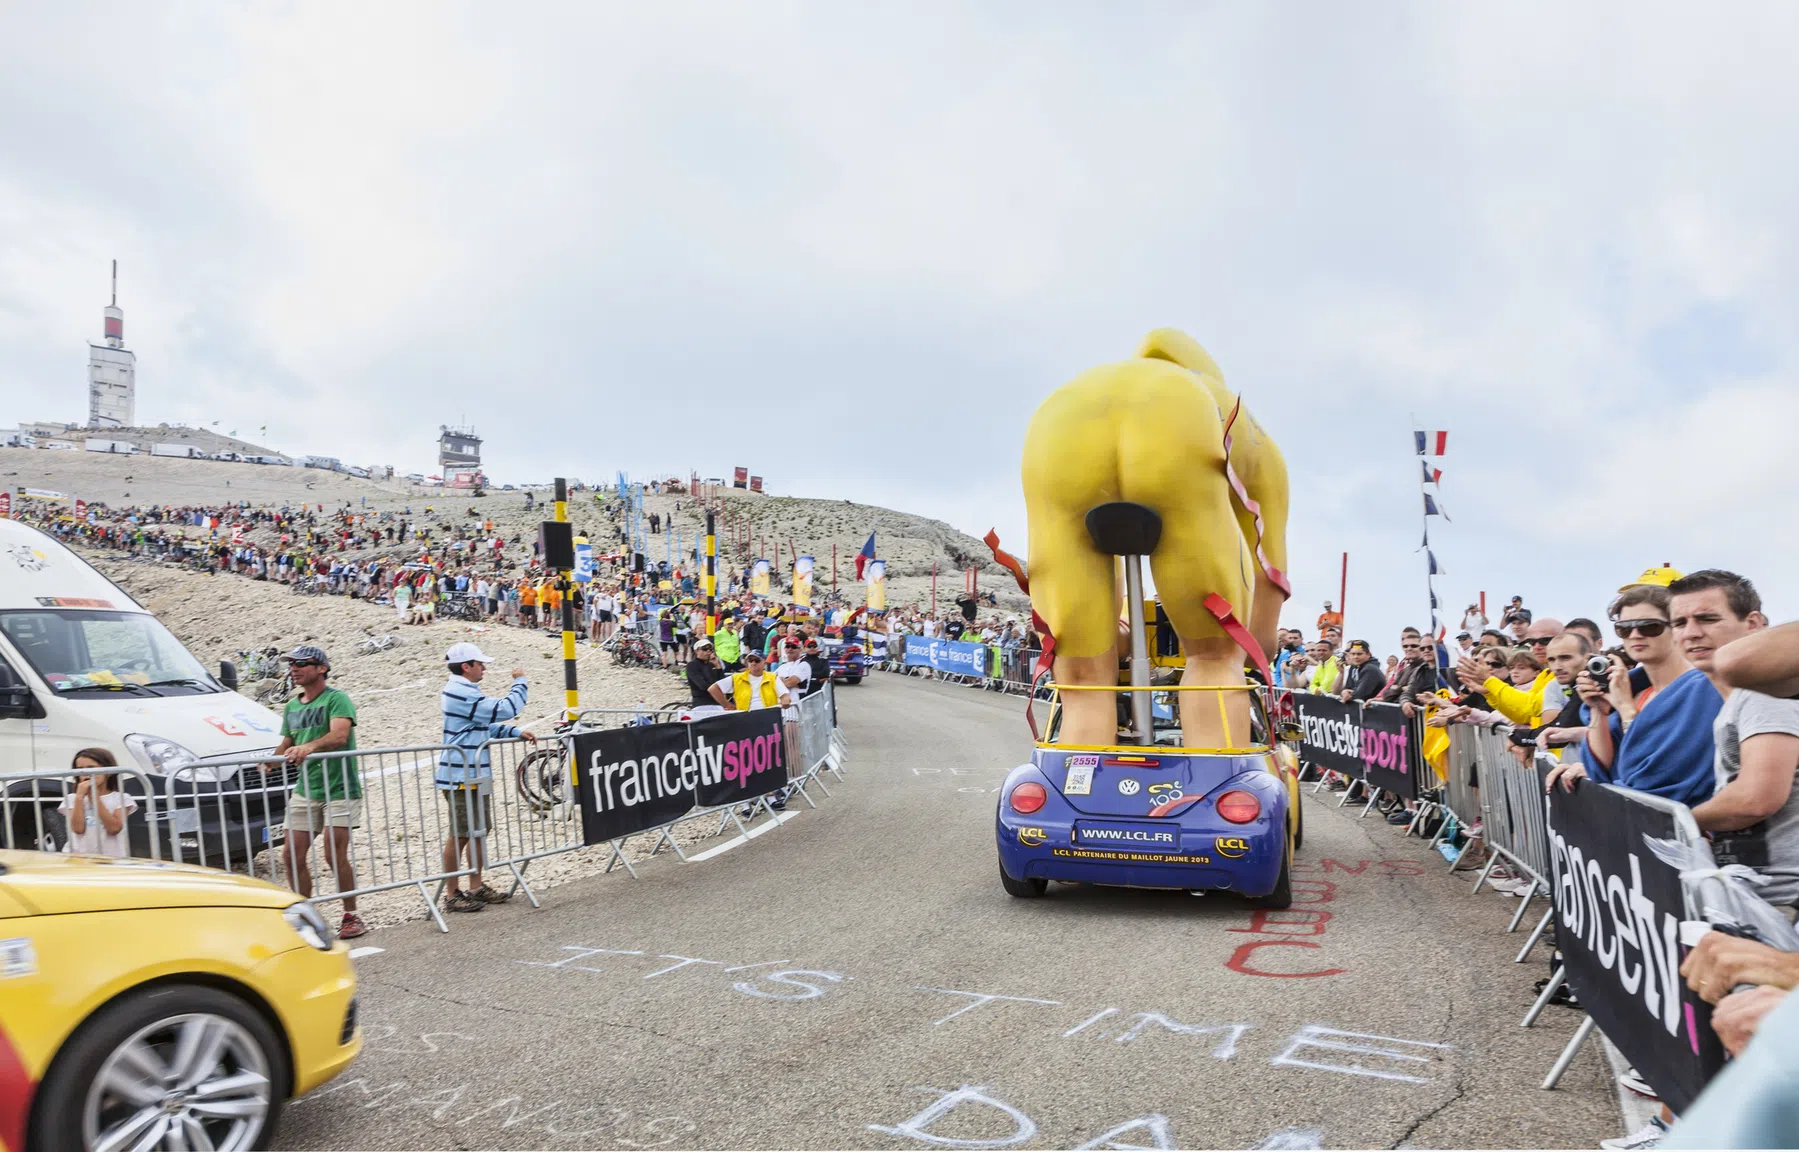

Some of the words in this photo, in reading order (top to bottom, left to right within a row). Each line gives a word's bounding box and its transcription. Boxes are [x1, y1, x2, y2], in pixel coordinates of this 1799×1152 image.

[1299, 704, 1408, 775] francetvsport
[589, 723, 782, 813] francetvsport
[1072, 757, 1098, 767] 2555
[1021, 827, 1047, 839] LCL
[1081, 828, 1173, 843] WWW.LCL.FR
[1218, 838, 1249, 850] LCL
[1053, 848, 1071, 857] LCL
[1073, 851, 1117, 860] PARTENAIRE
[1118, 853, 1129, 861] DU
[1131, 853, 1163, 862] MAILLOT
[1165, 855, 1189, 863] JAUNE
[1191, 856, 1210, 864] 2013
